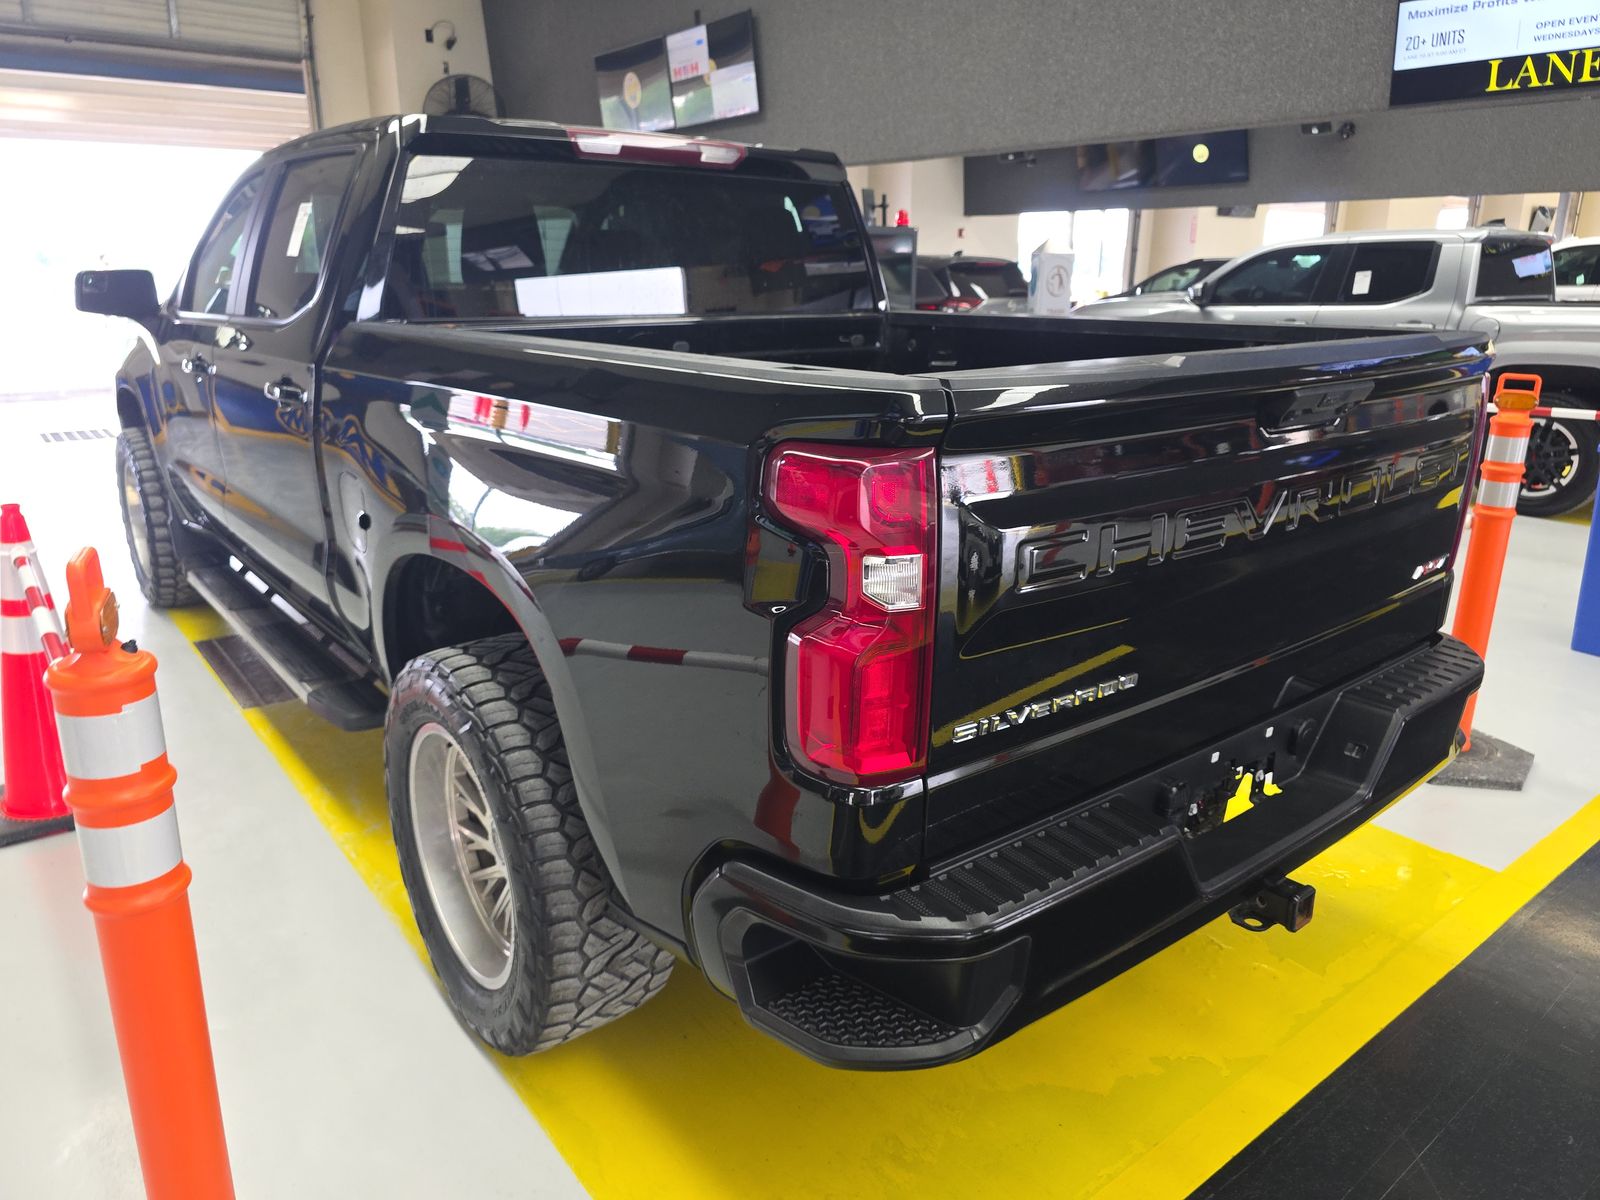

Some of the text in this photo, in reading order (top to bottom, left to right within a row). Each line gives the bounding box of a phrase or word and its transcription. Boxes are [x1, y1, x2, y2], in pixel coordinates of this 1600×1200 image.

[1408, 5, 1468, 20] Maximize
[1536, 13, 1600, 30] OPEN EVEN
[1405, 29, 1465, 51] 20+ UNITS
[1533, 27, 1600, 42] WEDNESDAYS
[1485, 48, 1600, 92] LANE
[1014, 442, 1469, 593] CHEVROLET
[952, 672, 1139, 744] SILVERADO
